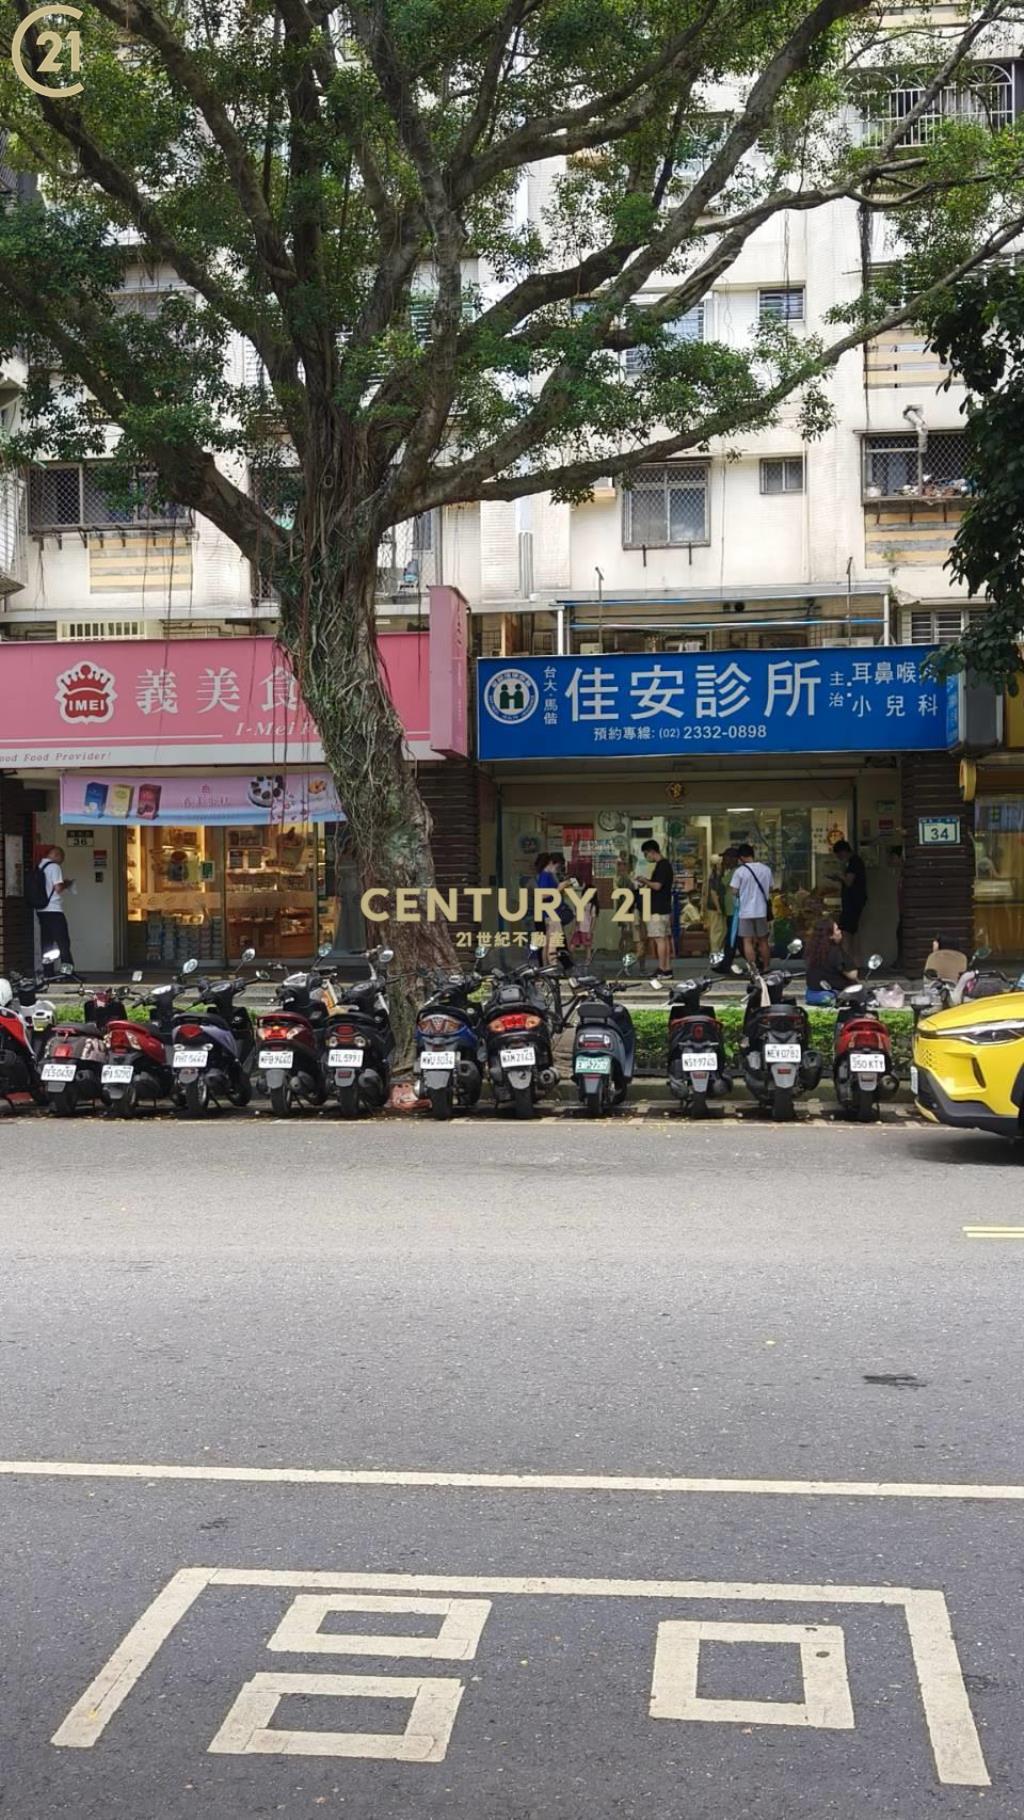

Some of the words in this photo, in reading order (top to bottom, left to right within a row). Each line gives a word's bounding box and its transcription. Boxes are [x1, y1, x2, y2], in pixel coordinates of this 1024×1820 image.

[565, 659, 822, 722] 佳安診所
[68, 698, 105, 711] IMEI
[852, 694, 938, 718] 小兒科
[659, 727, 681, 739] (02)
[683, 725, 768, 740] 2332-0898
[930, 827, 949, 840] 34
